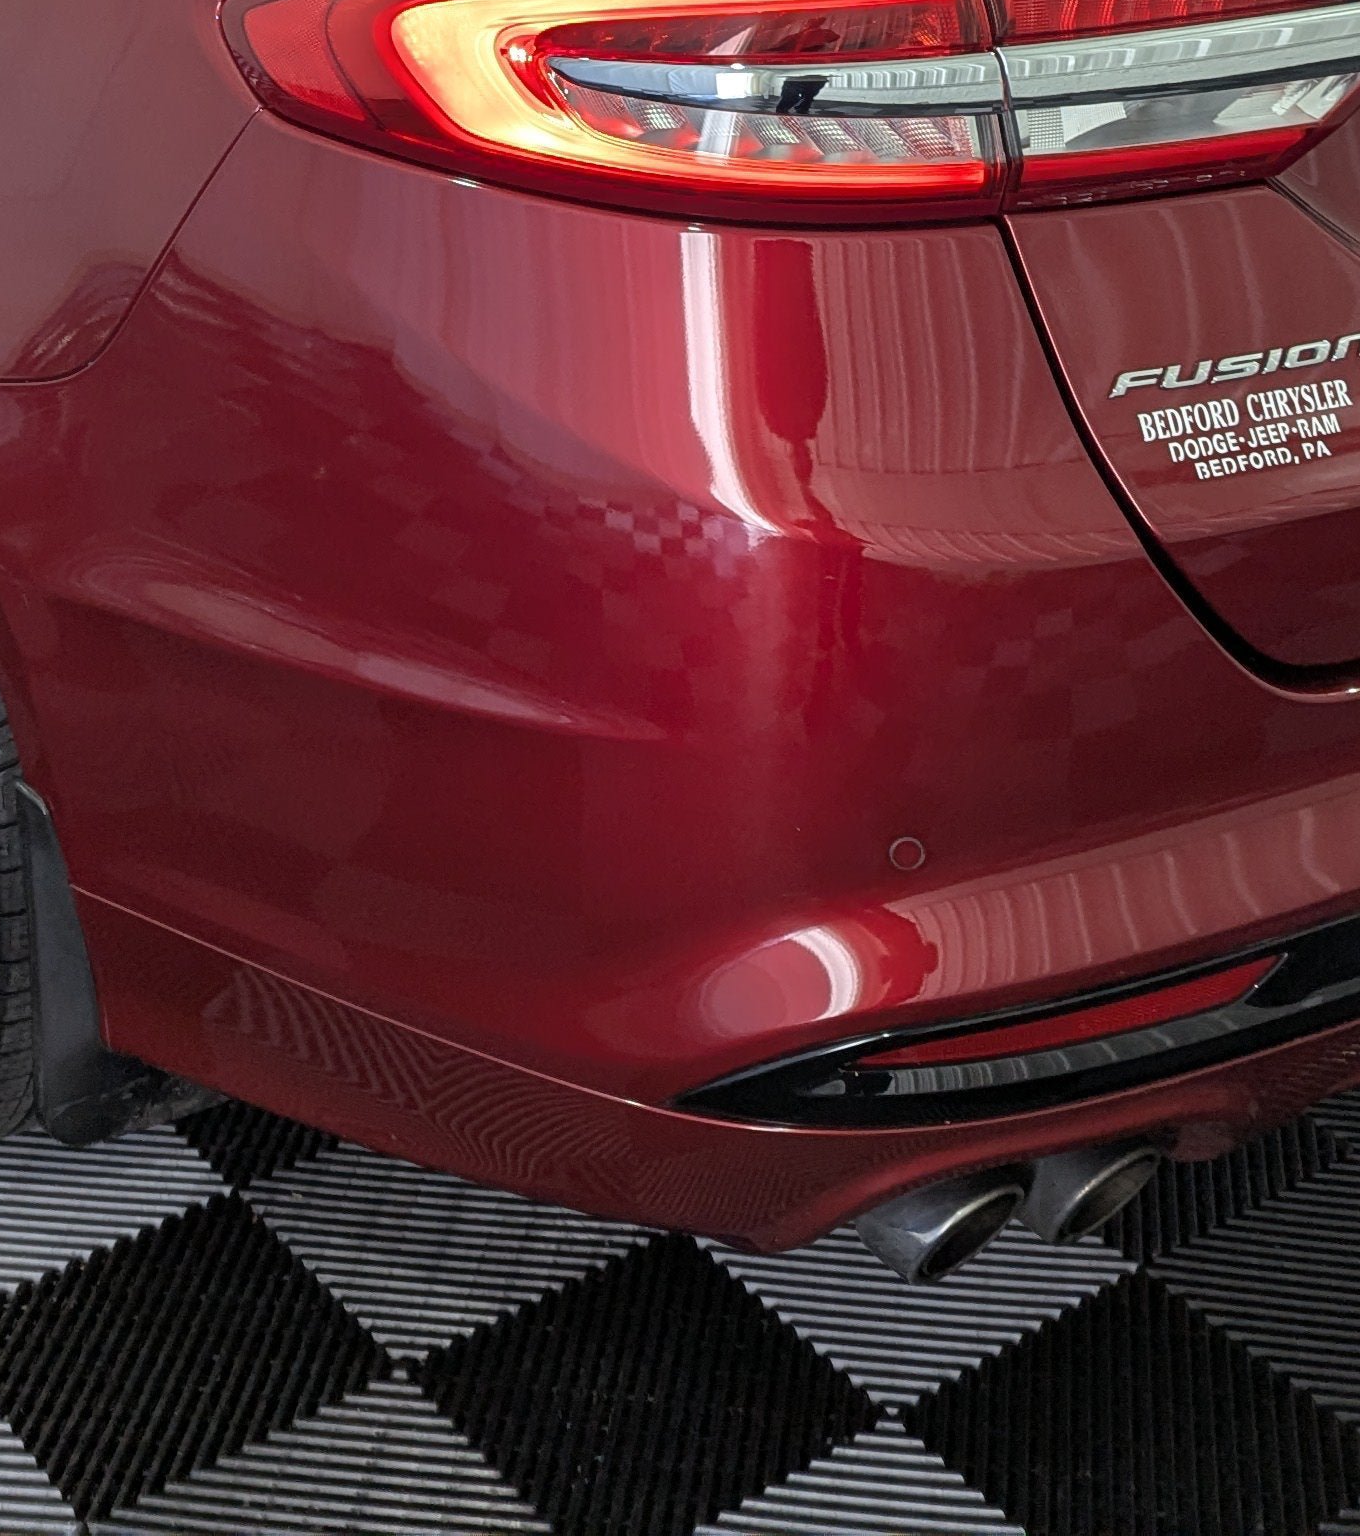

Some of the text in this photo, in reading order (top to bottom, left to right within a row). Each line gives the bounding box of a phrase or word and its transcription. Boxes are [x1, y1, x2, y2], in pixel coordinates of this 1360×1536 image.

[1137, 379, 1353, 444] BEDFORD CHRYSLER
[1194, 441, 1333, 480] BEDFORD, PA
